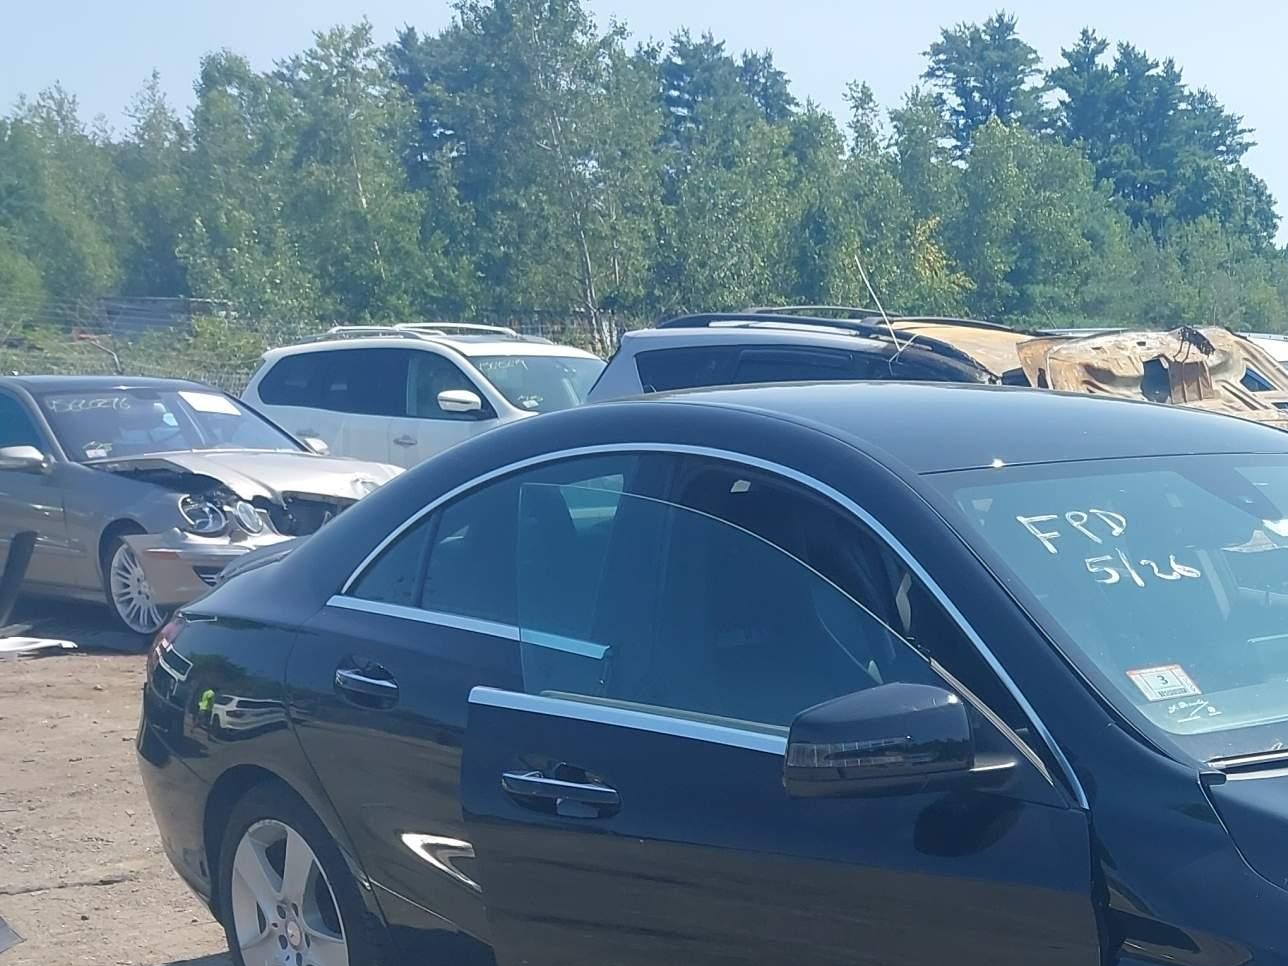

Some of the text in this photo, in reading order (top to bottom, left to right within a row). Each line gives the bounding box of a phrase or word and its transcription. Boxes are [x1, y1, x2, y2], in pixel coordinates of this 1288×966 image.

[1016, 508, 1127, 554] FPD
[1084, 547, 1201, 588] 5/26
[1156, 675, 1169, 686] 3
